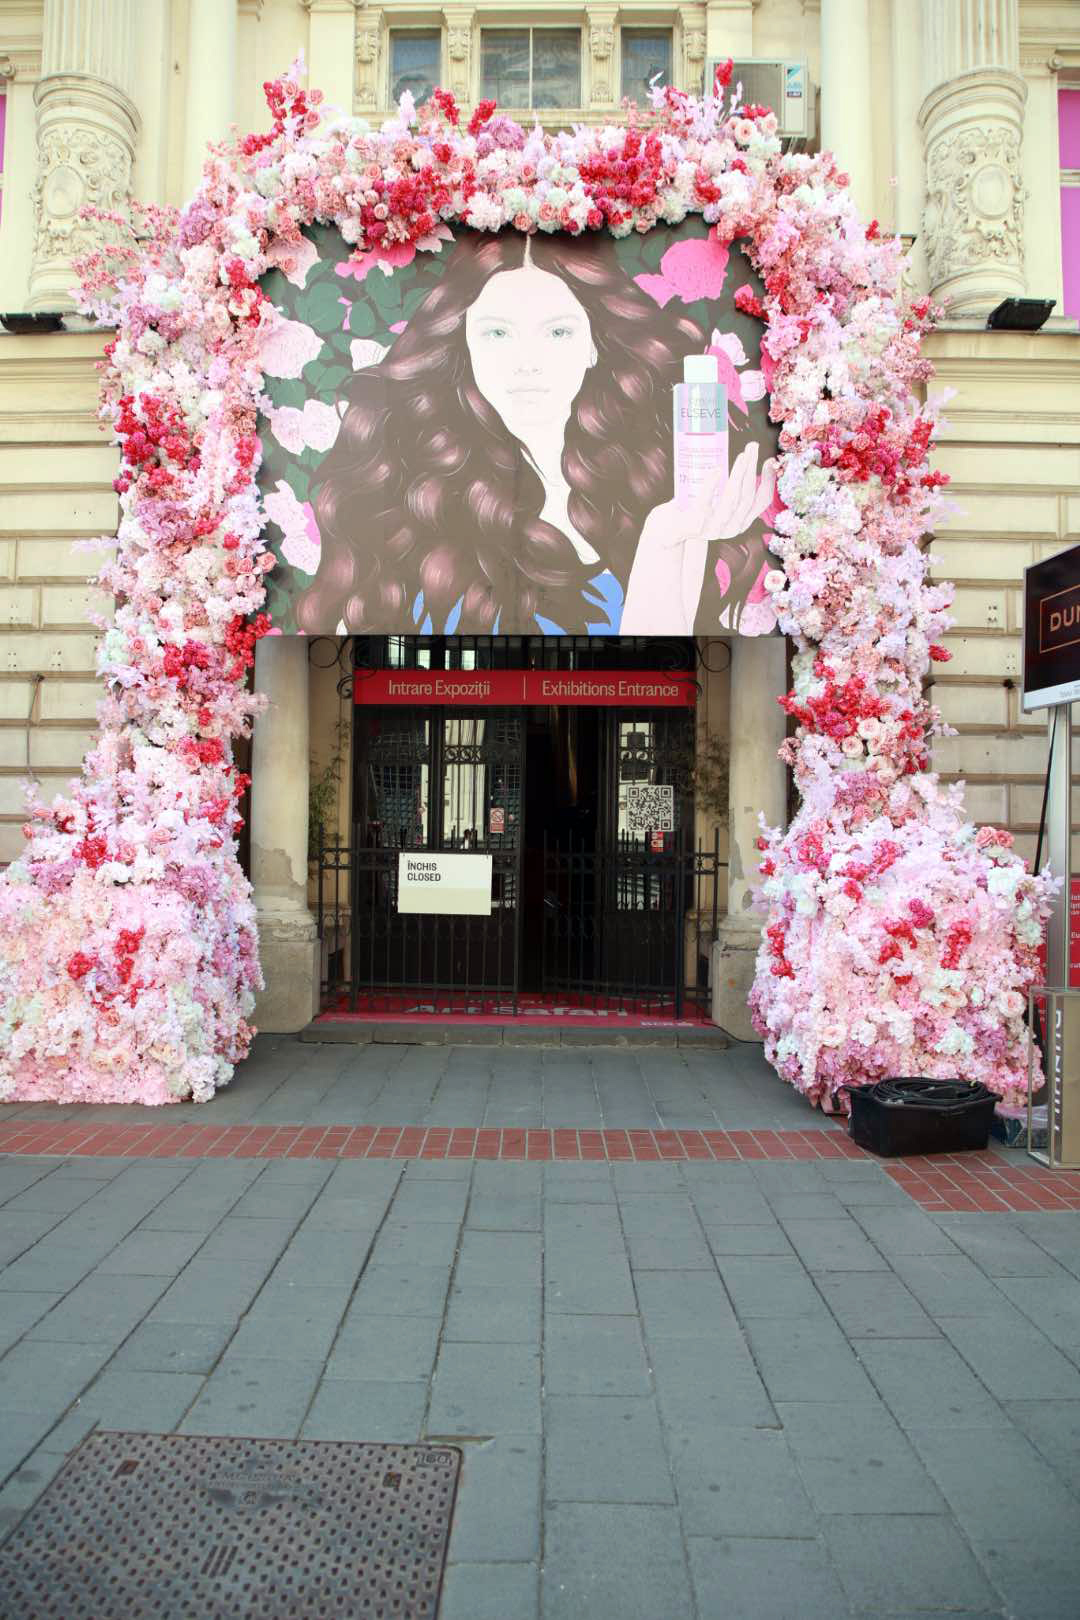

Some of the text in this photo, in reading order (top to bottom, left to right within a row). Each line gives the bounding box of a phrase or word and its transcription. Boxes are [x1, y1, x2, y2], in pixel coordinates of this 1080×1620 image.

[388, 679, 433, 695] Intrare
[542, 680, 679, 697] Exhibitions Entrance
[407, 872, 441, 882] CLOSED
